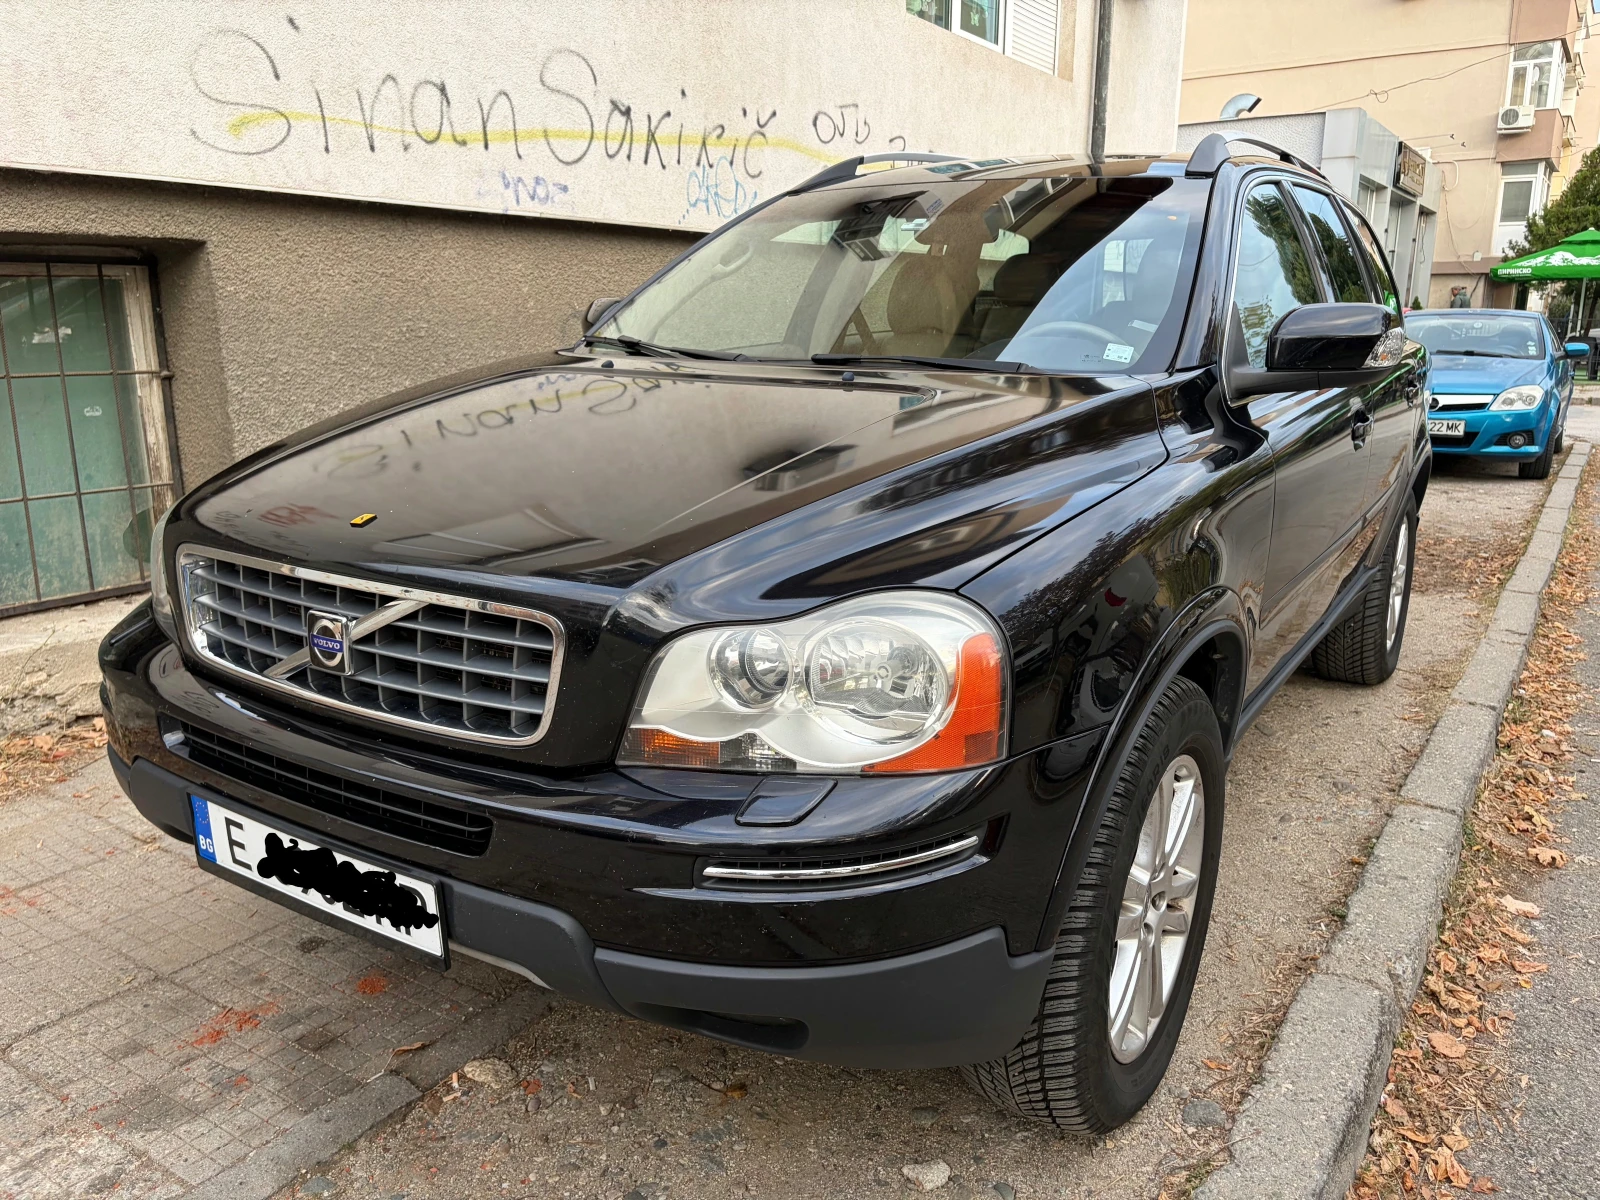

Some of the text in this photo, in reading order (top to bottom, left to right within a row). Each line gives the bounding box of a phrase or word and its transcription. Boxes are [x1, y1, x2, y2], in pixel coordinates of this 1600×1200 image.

[189, 15, 522, 159] Sinan
[1446, 422, 1461, 433] MK
[313, 638, 340, 650] VOLVO
[199, 834, 213, 853] BG
[224, 815, 253, 872] E
